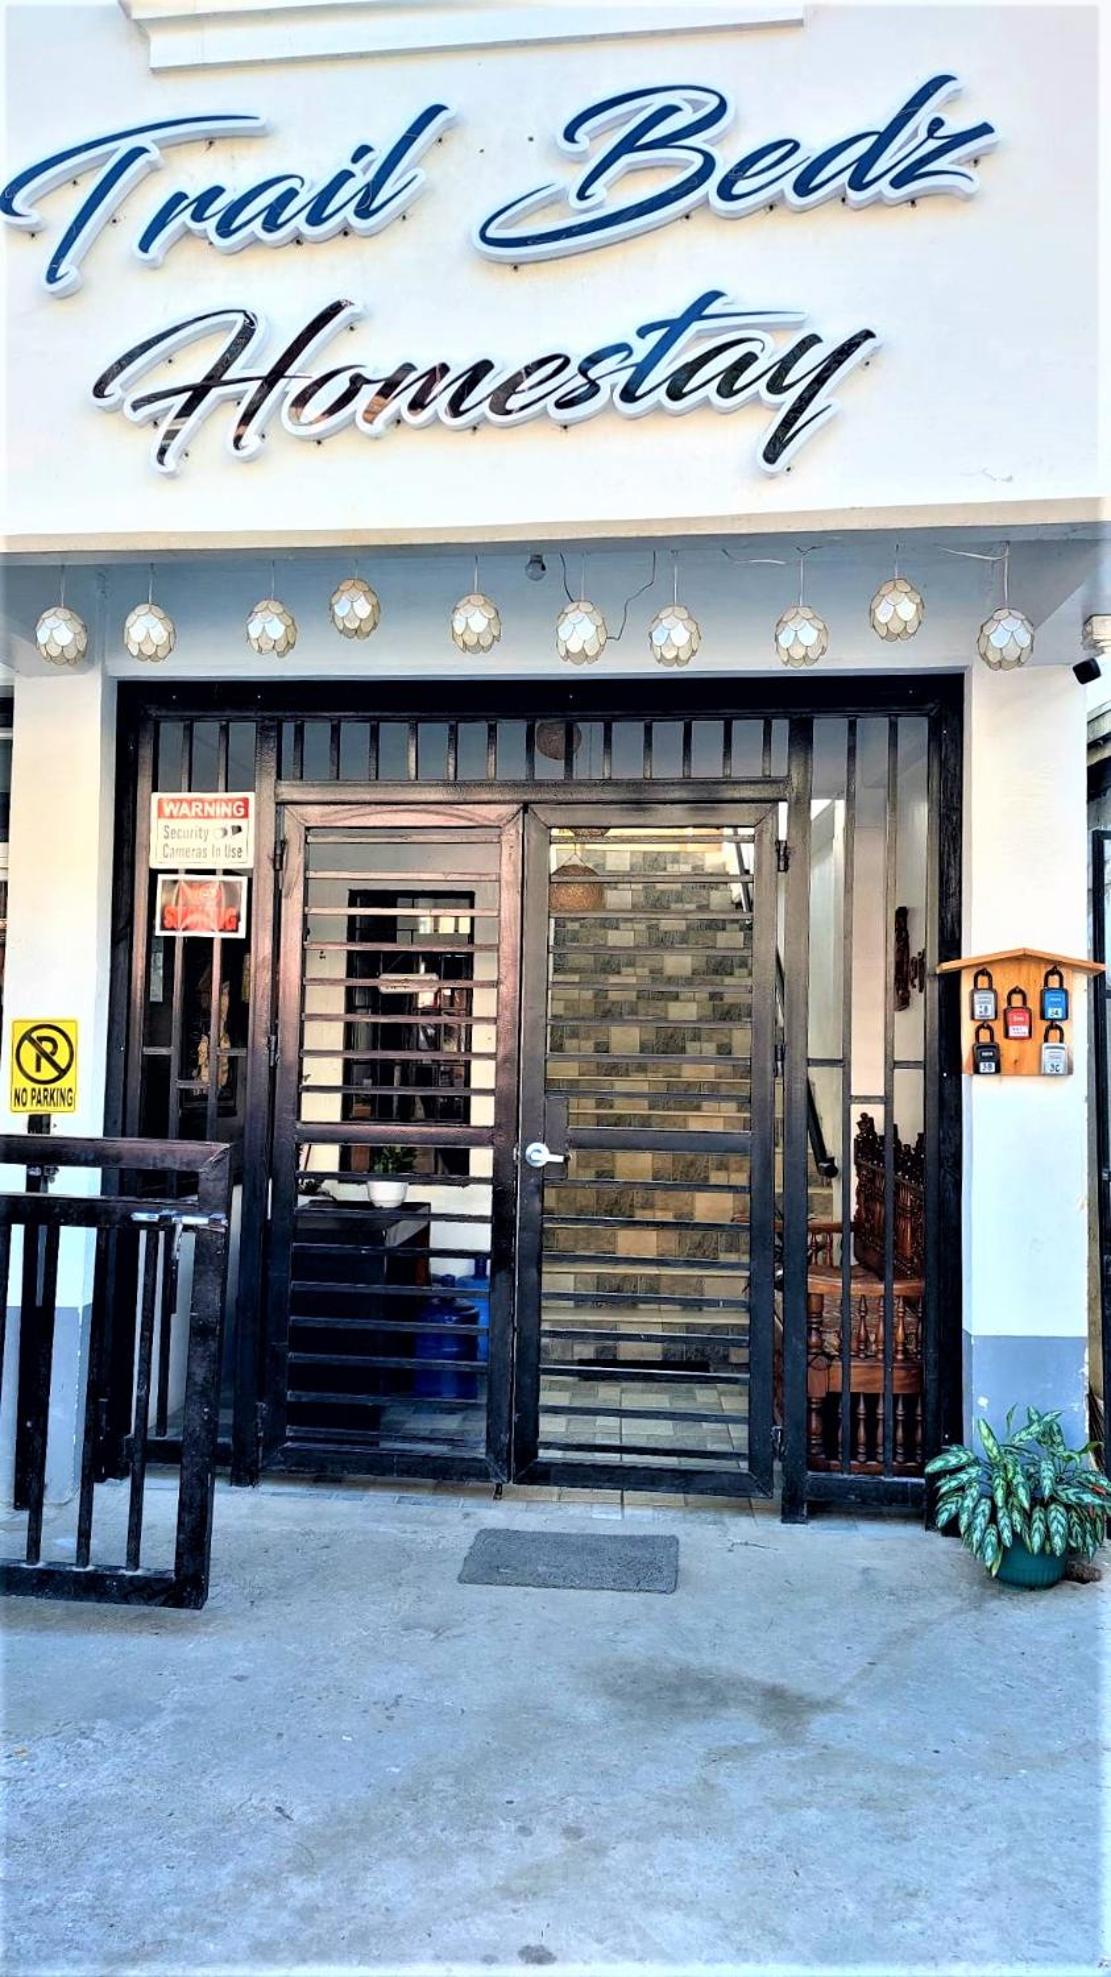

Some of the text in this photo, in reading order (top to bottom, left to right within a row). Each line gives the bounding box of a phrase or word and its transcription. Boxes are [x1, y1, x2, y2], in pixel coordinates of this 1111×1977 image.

[1, 74, 996, 285] Trail Bedz
[92, 289, 877, 466] Homestay
[163, 800, 245, 817] WARNING
[163, 825, 209, 841] Security
[163, 843, 243, 859] Cameras In Use
[14, 1087, 73, 1107] NO PARKING
